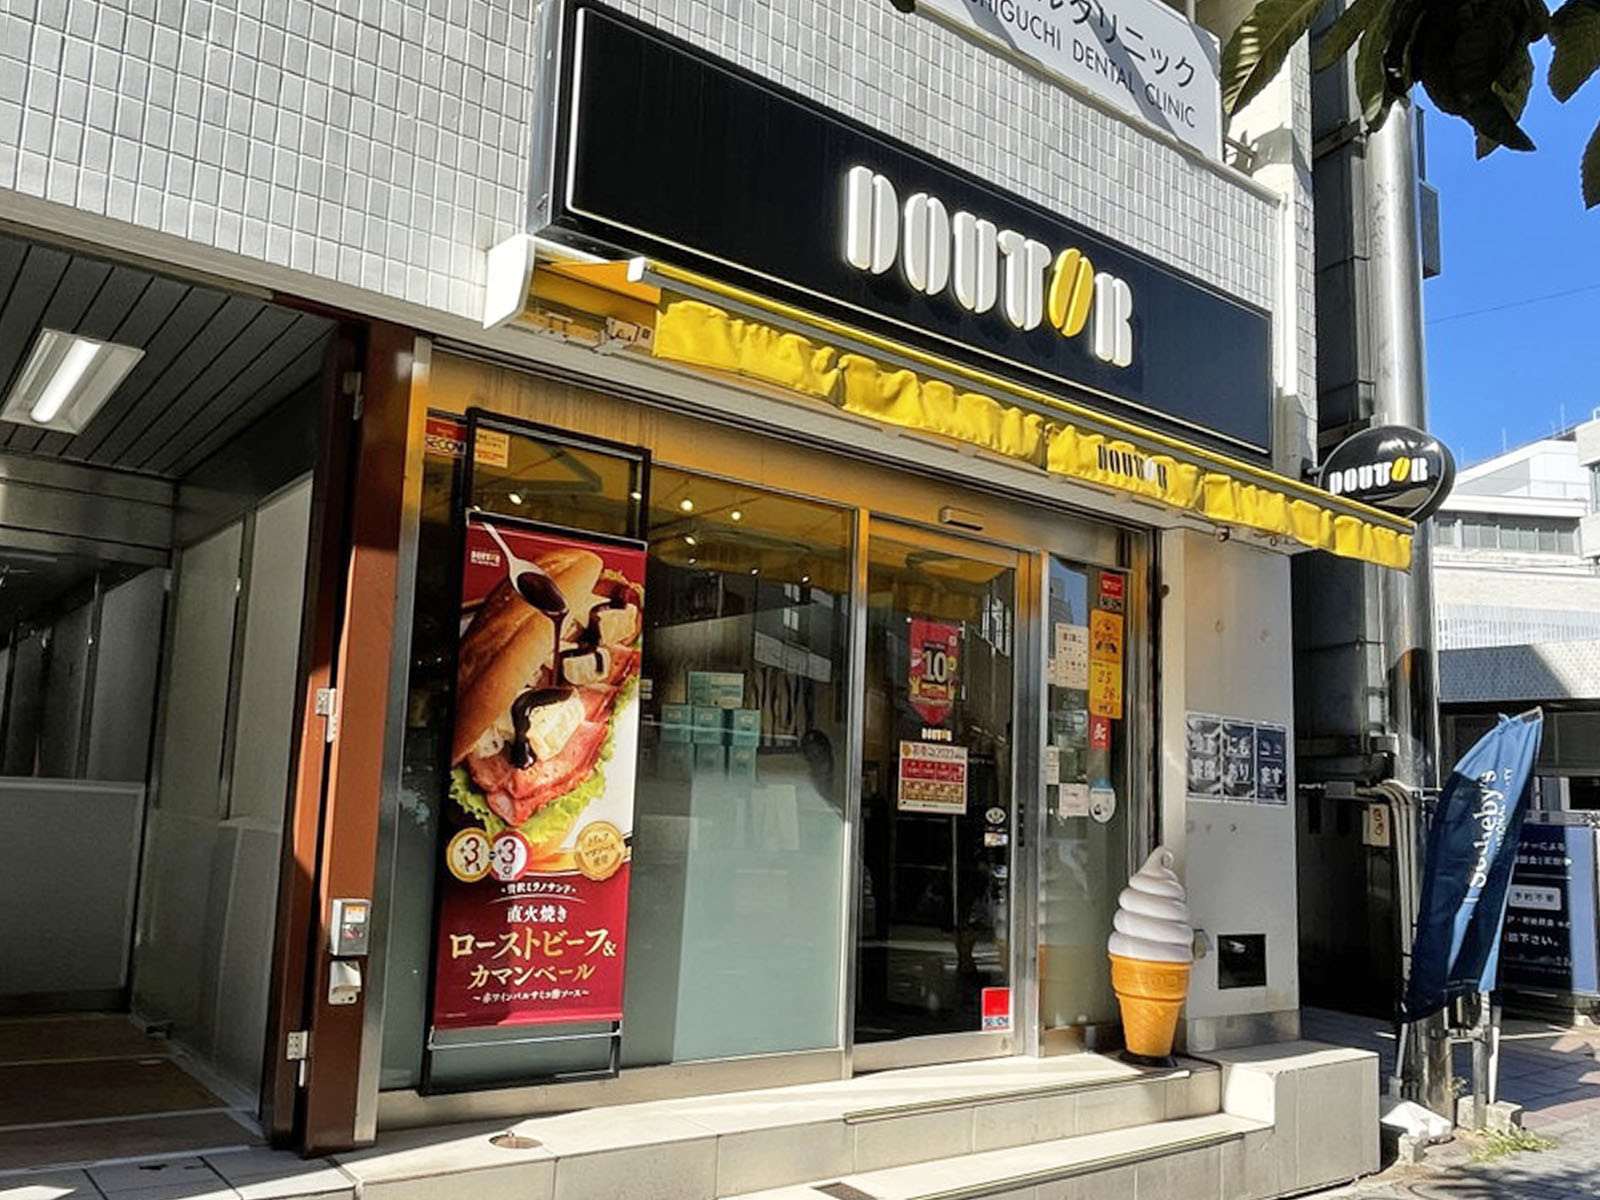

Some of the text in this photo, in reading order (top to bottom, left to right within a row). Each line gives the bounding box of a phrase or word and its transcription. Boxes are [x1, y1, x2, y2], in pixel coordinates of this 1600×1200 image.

[970, 0, 1196, 128] IGUCHI DENTAL CLINIC
[845, 165, 1133, 368] DOUTOR
[1098, 444, 1167, 490] DOUTOR
[1329, 456, 1429, 494] DOUTOR
[507, 905, 568, 923] 直火焼き
[450, 926, 617, 960] ローストビーフ&
[467, 963, 596, 990] カマンベール
